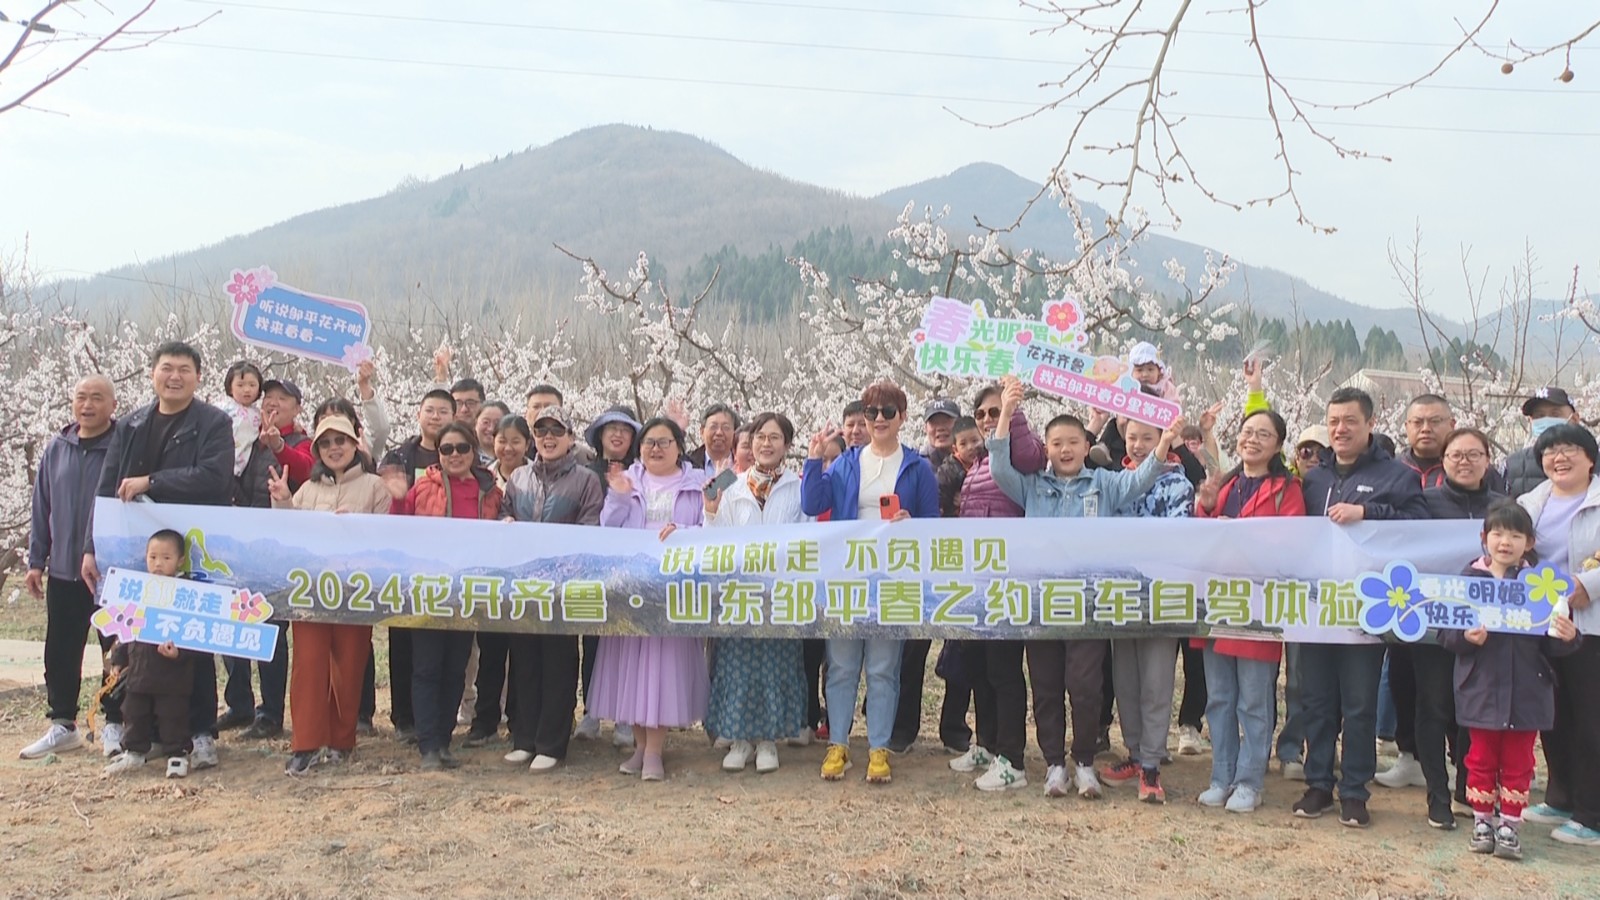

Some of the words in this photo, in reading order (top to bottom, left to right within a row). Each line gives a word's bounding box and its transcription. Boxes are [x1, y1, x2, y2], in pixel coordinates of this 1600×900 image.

[259, 300, 363, 338] 听说邹平花开啦
[919, 342, 1034, 380] 快乐春
[1027, 344, 1086, 374] 花开齐鲁
[1039, 369, 1173, 423] 我在邹平春日里等你
[660, 539, 820, 574] 说邹就走
[845, 537, 1009, 573] 不负遇见
[118, 577, 223, 615] 说邹就走
[1420, 577, 1527, 606] 春光明媚
[154, 613, 262, 652] 不负遇见
[1424, 602, 1533, 631] 快乐春游
